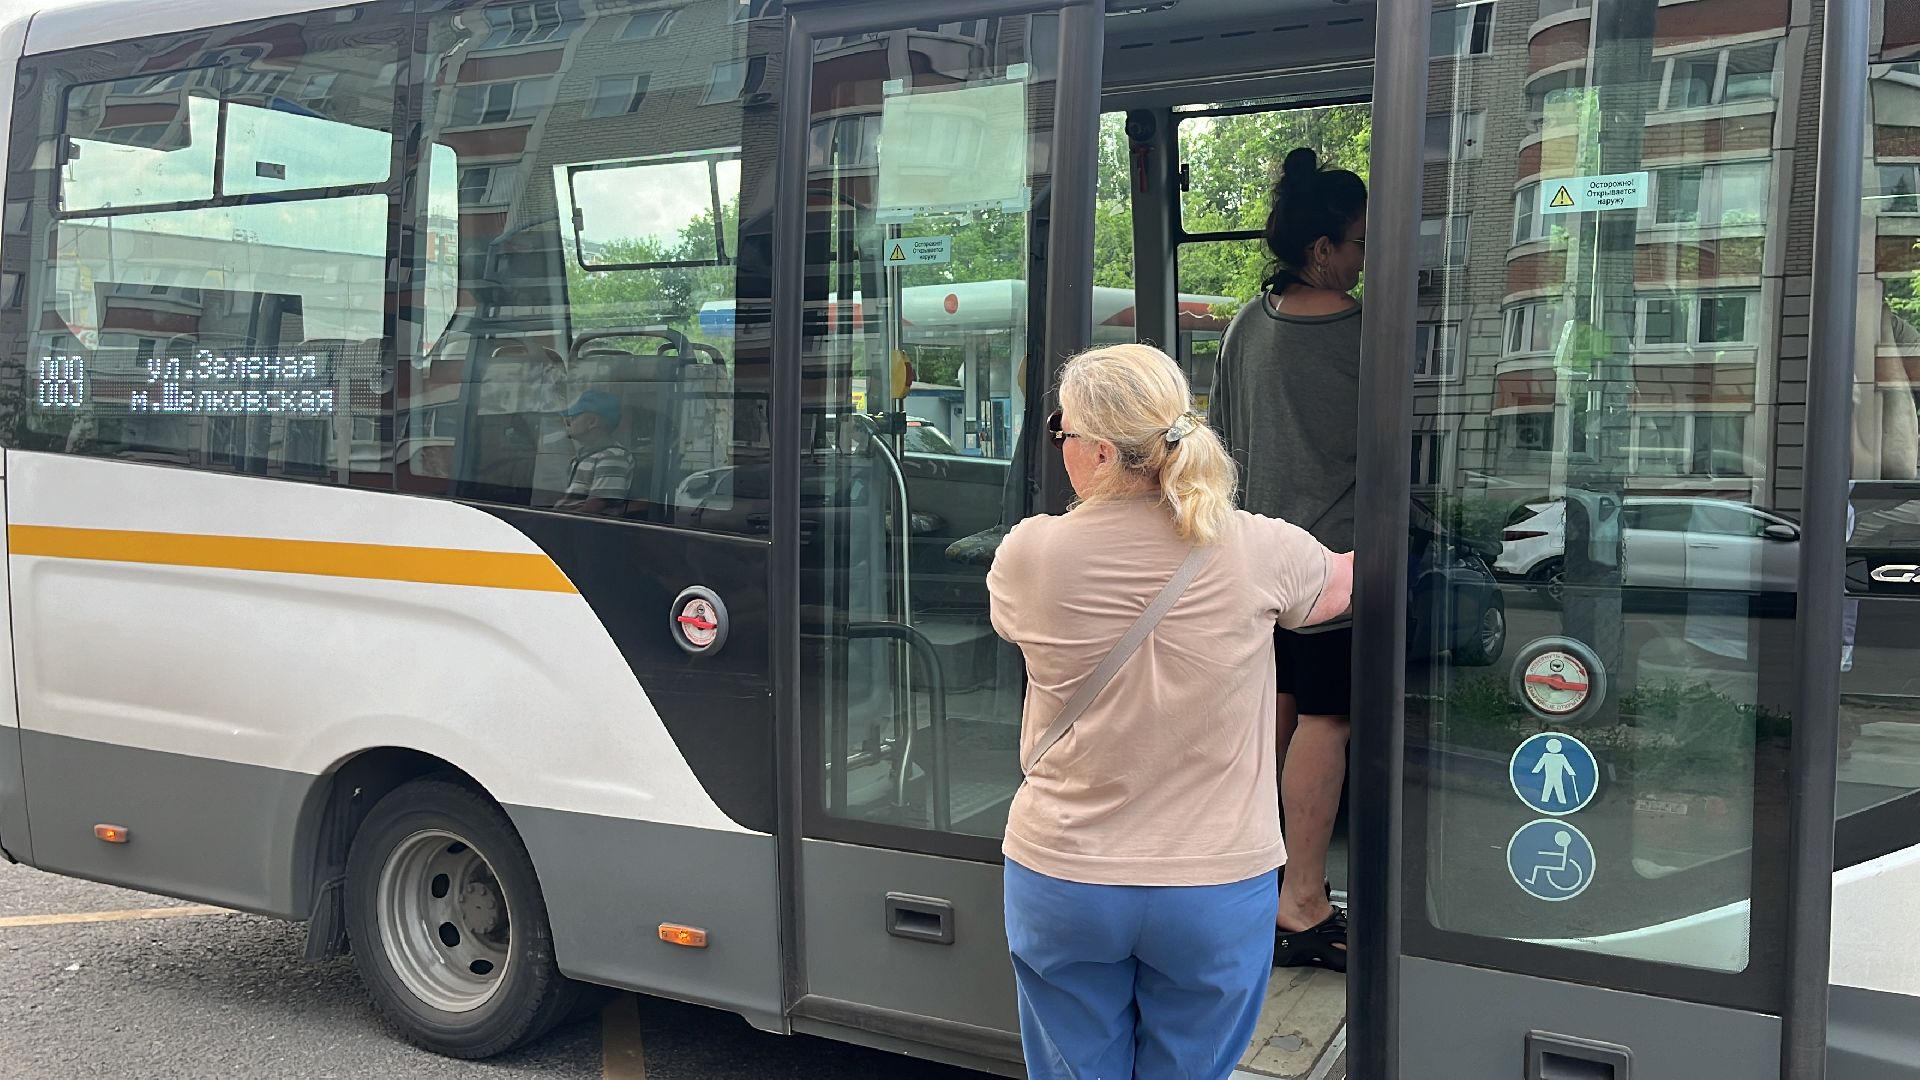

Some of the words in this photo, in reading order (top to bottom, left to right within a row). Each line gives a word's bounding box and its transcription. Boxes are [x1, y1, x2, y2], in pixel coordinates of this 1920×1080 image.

[1589, 179, 1634, 189] Осторожно!
[1586, 188, 1636, 198] Открывается
[1597, 197, 1625, 205] наружу
[147, 349, 316, 382] ул.Зеленая
[131, 382, 333, 411] м.Щелковская
